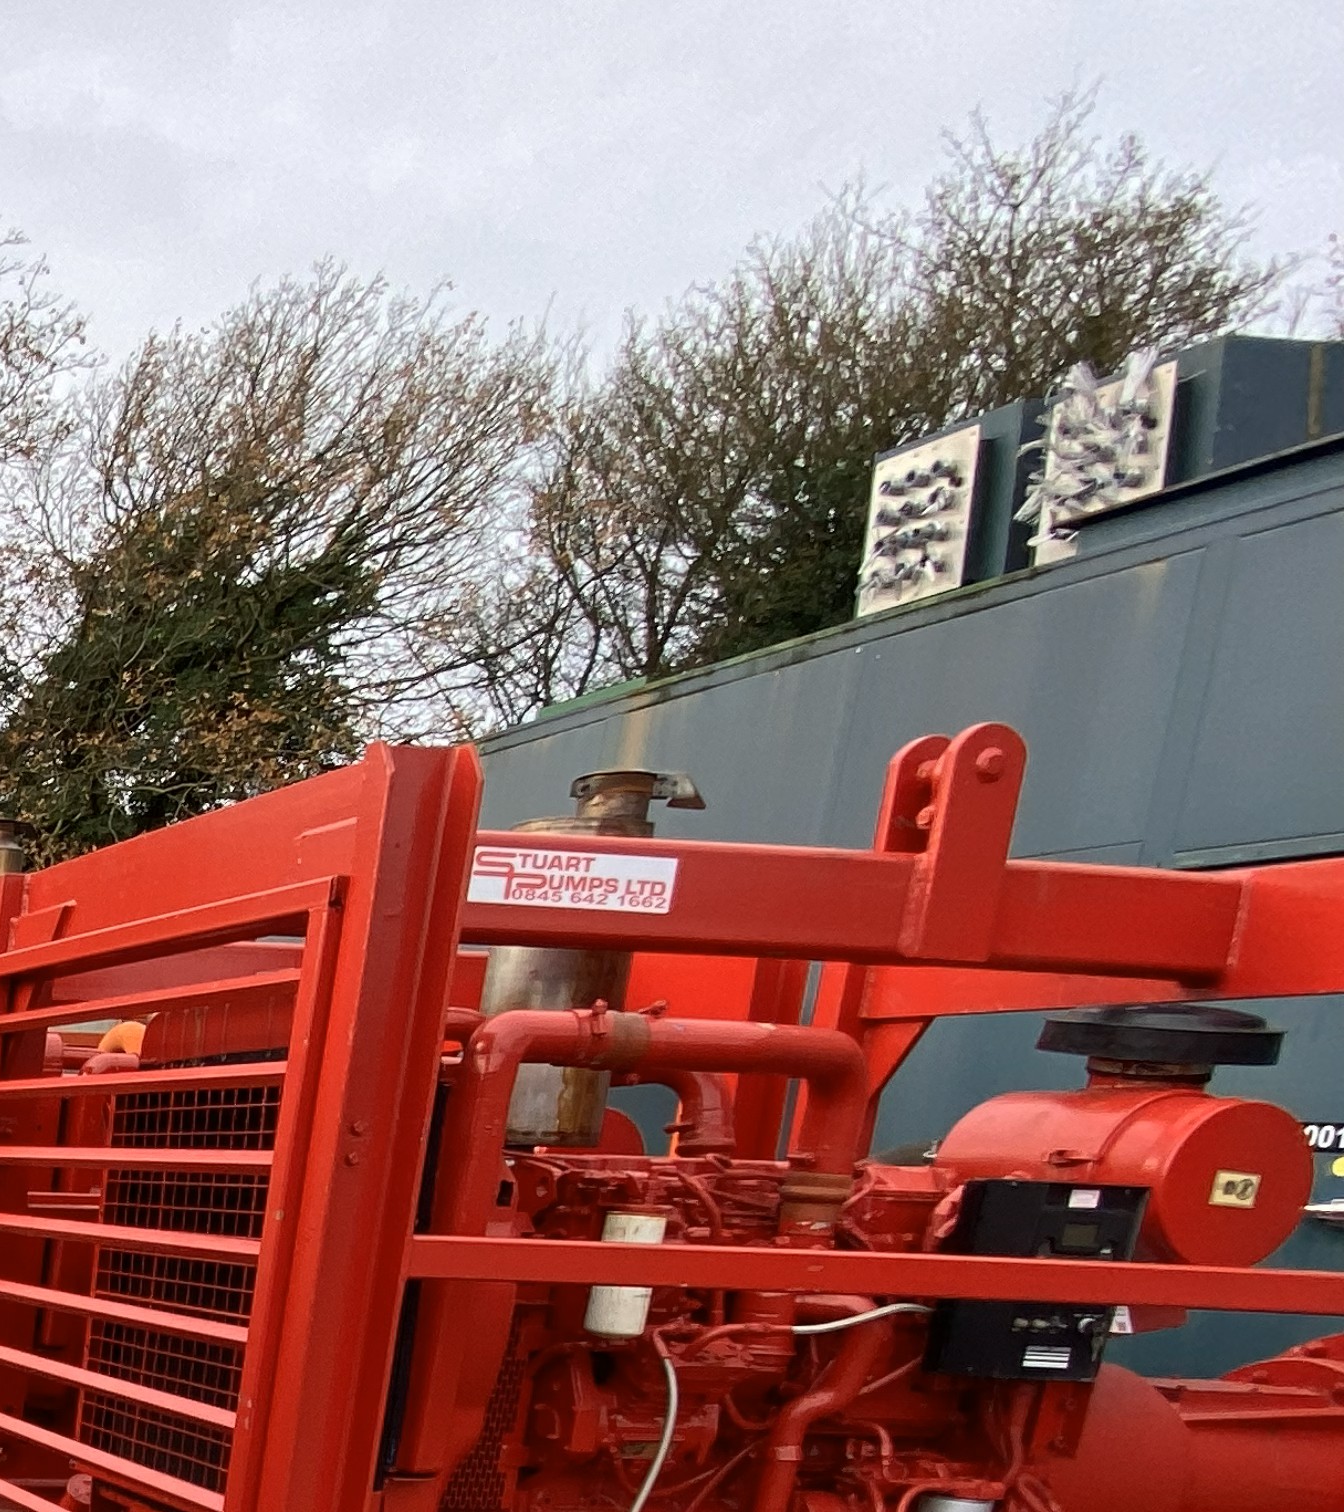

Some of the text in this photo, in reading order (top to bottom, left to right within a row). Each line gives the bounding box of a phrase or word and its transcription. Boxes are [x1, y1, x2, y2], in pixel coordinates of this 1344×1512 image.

[474, 851, 596, 876] STUART
[504, 873, 667, 898] PUMPS LTD
[512, 888, 667, 909] 0845 642 1662
